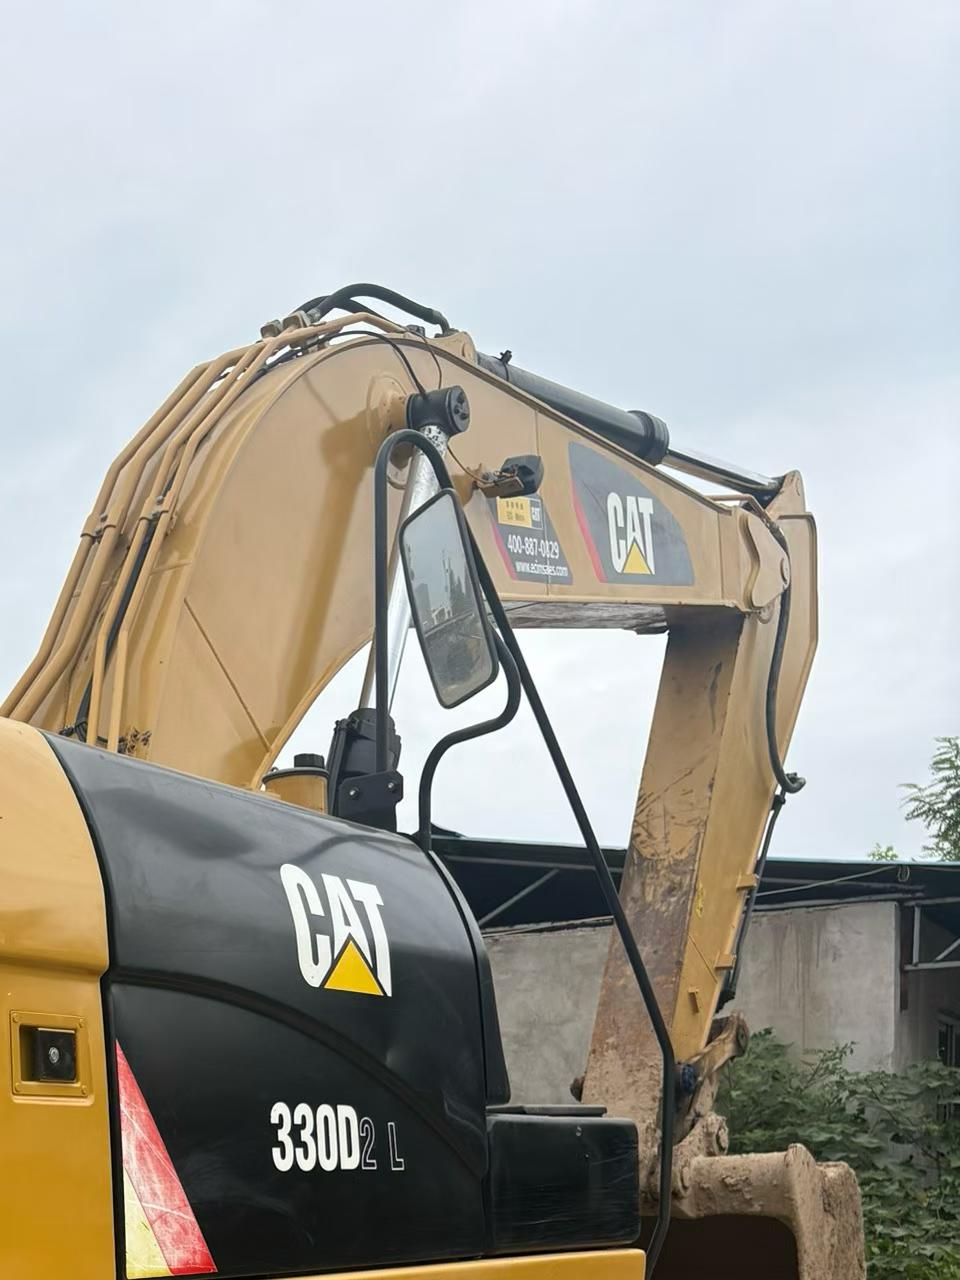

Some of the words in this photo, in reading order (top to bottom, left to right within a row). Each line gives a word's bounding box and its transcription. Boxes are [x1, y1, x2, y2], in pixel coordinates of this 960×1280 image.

[607, 492, 655, 575] CAT
[280, 863, 392, 997] CAT
[387, 1122, 405, 1171] L
